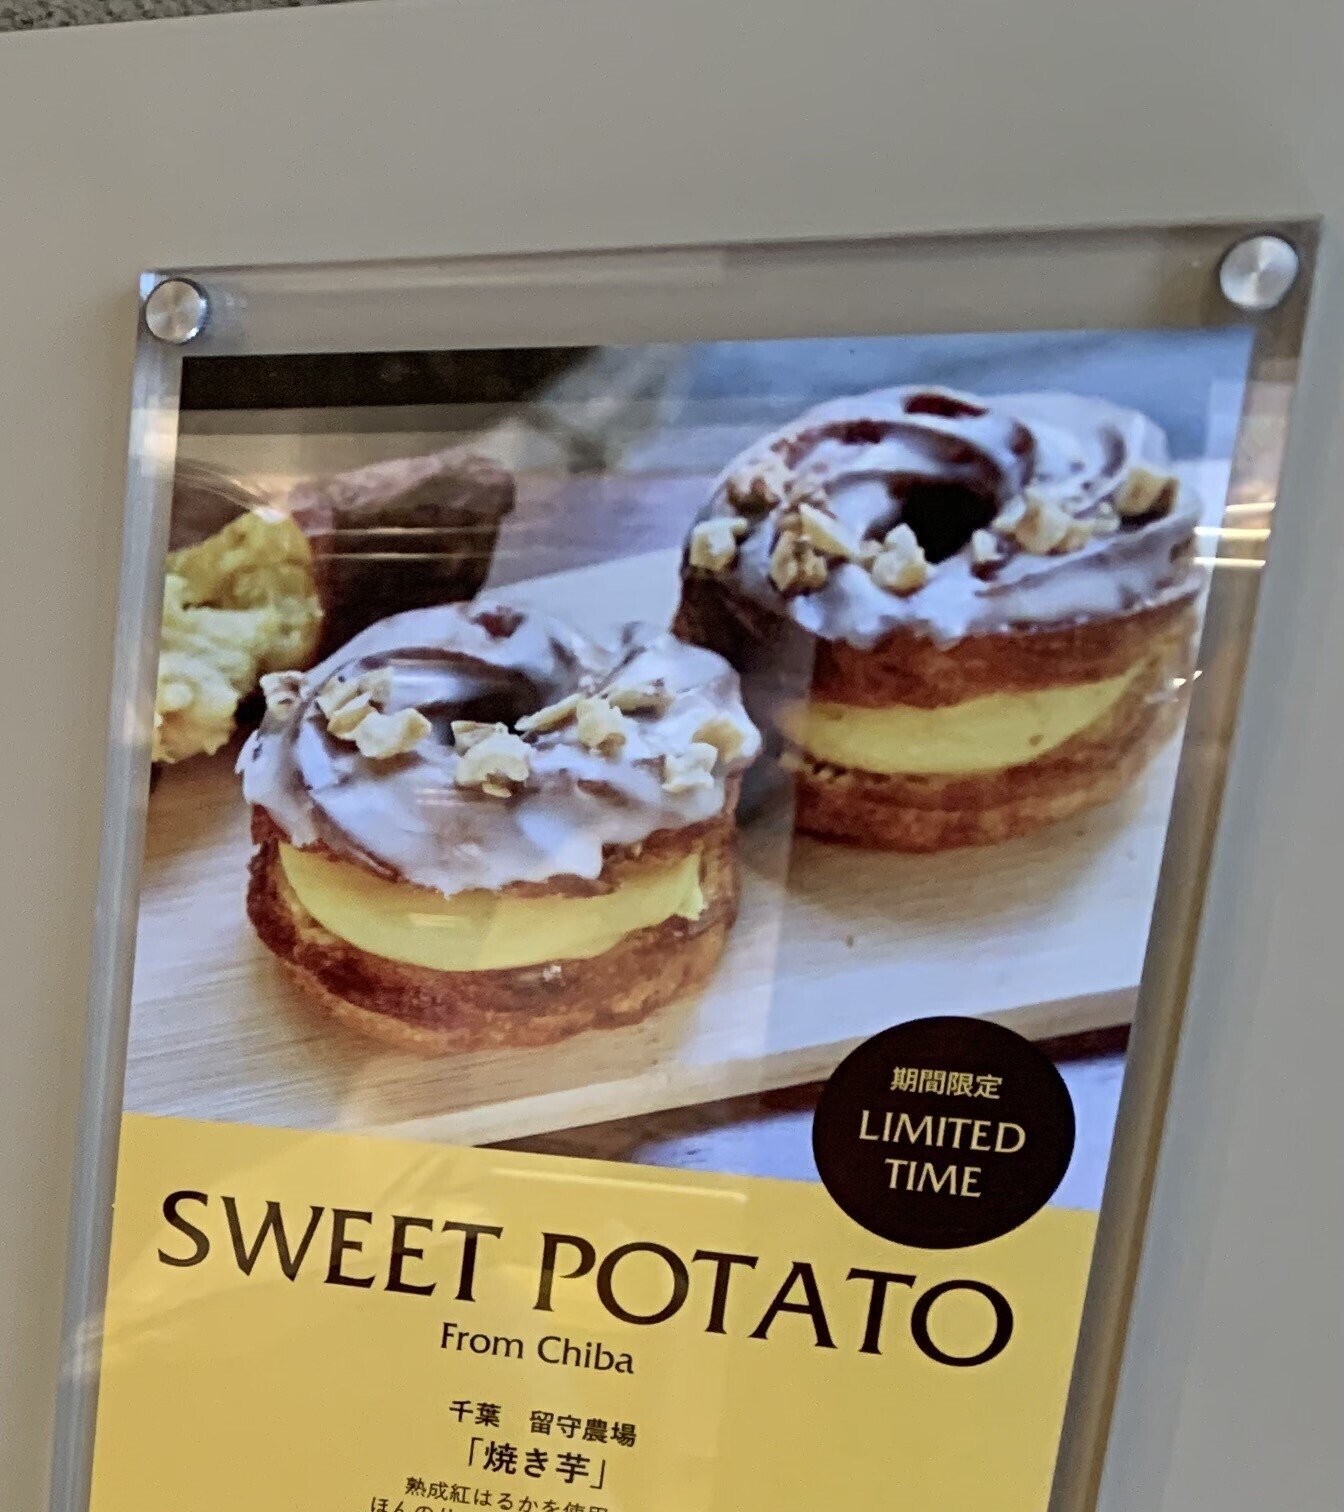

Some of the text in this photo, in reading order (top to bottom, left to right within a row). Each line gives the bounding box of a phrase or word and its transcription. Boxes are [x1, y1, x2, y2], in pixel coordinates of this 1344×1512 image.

[890, 1066, 1004, 1100] 期間限定
[859, 1109, 1027, 1153] LIMITED
[884, 1158, 983, 1198] TIME
[157, 1189, 1015, 1368] SWEET POTATO
[440, 1321, 635, 1375] From Chiba
[448, 1400, 638, 1448] 千葉 留守農場
[468, 1436, 606, 1490] 「焼き芋」
